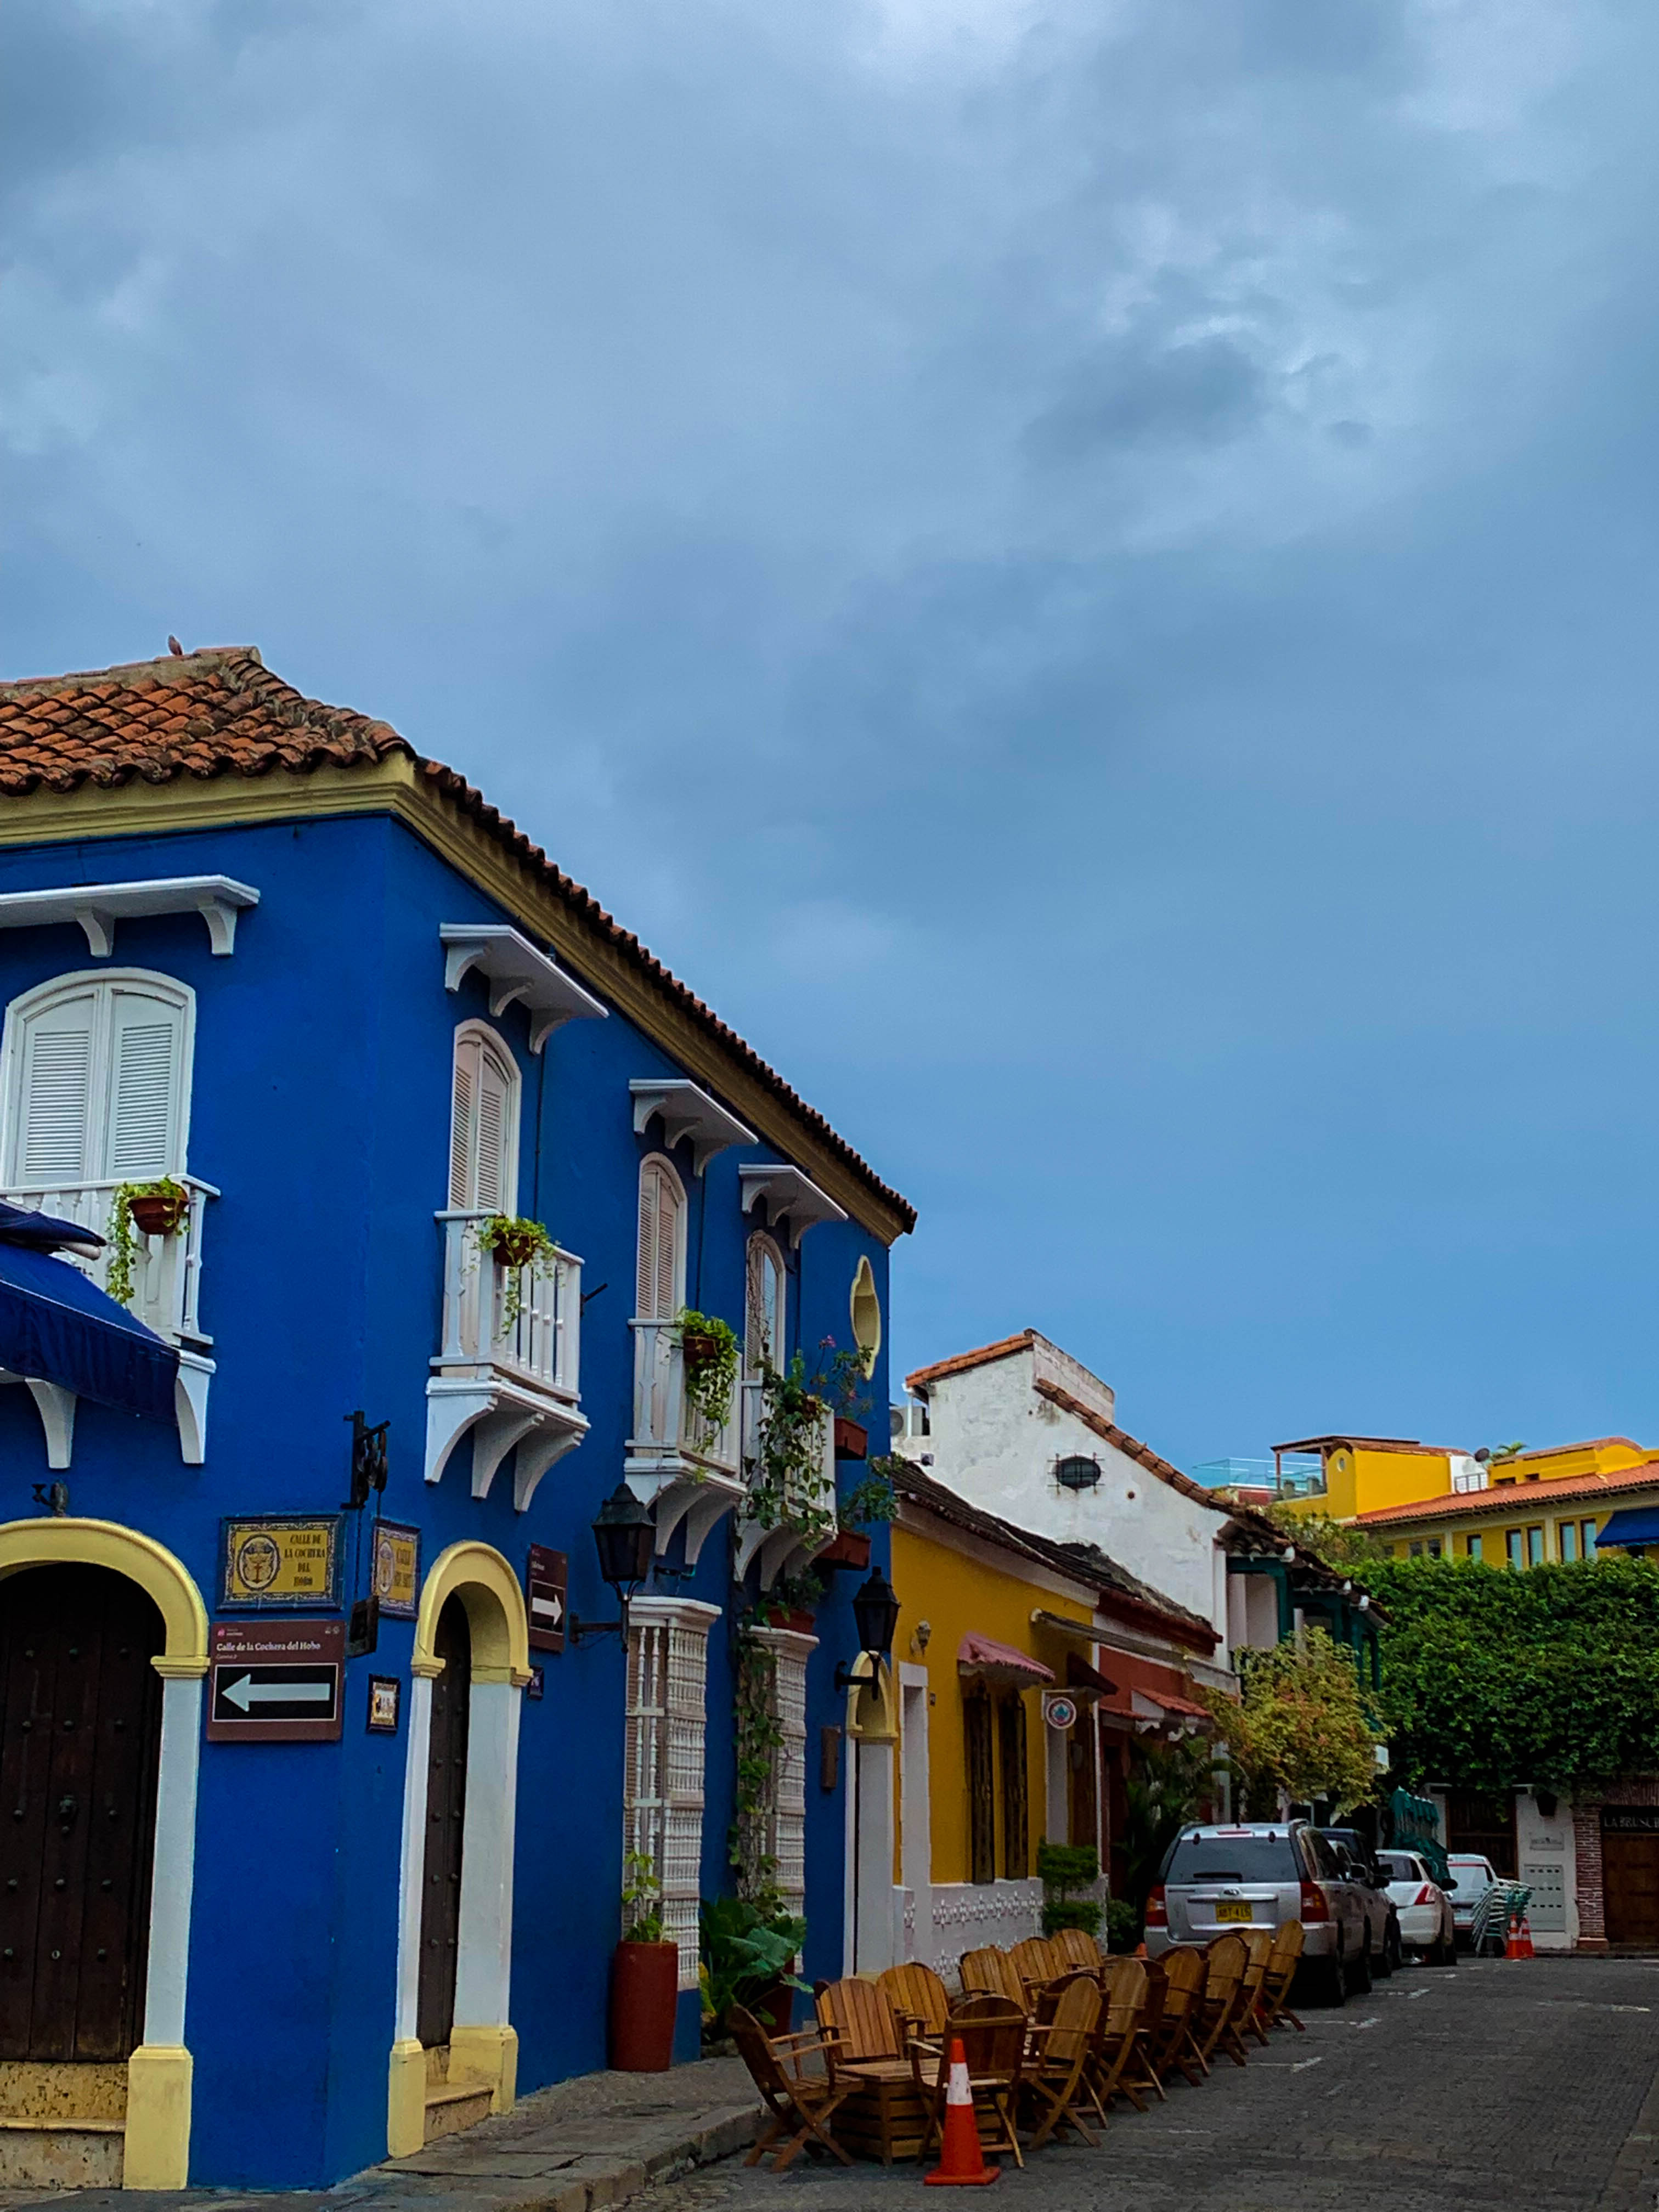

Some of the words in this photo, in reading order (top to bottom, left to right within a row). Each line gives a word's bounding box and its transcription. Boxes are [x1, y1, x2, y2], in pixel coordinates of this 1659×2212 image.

[290, 1534, 311, 1544] CALLE
[313, 1534, 321, 1544] DE
[284, 1549, 292, 1558] LA
[295, 1549, 325, 1558] COCHERA
[298, 1562, 311, 1572] DEL
[216, 1643, 235, 1651] Calle
[236, 1643, 245, 1651] de
[246, 1642, 254, 1651] la
[255, 1642, 285, 1651] Cochera
[286, 1641, 298, 1650] del
[300, 1640, 321, 1650] Hobo
